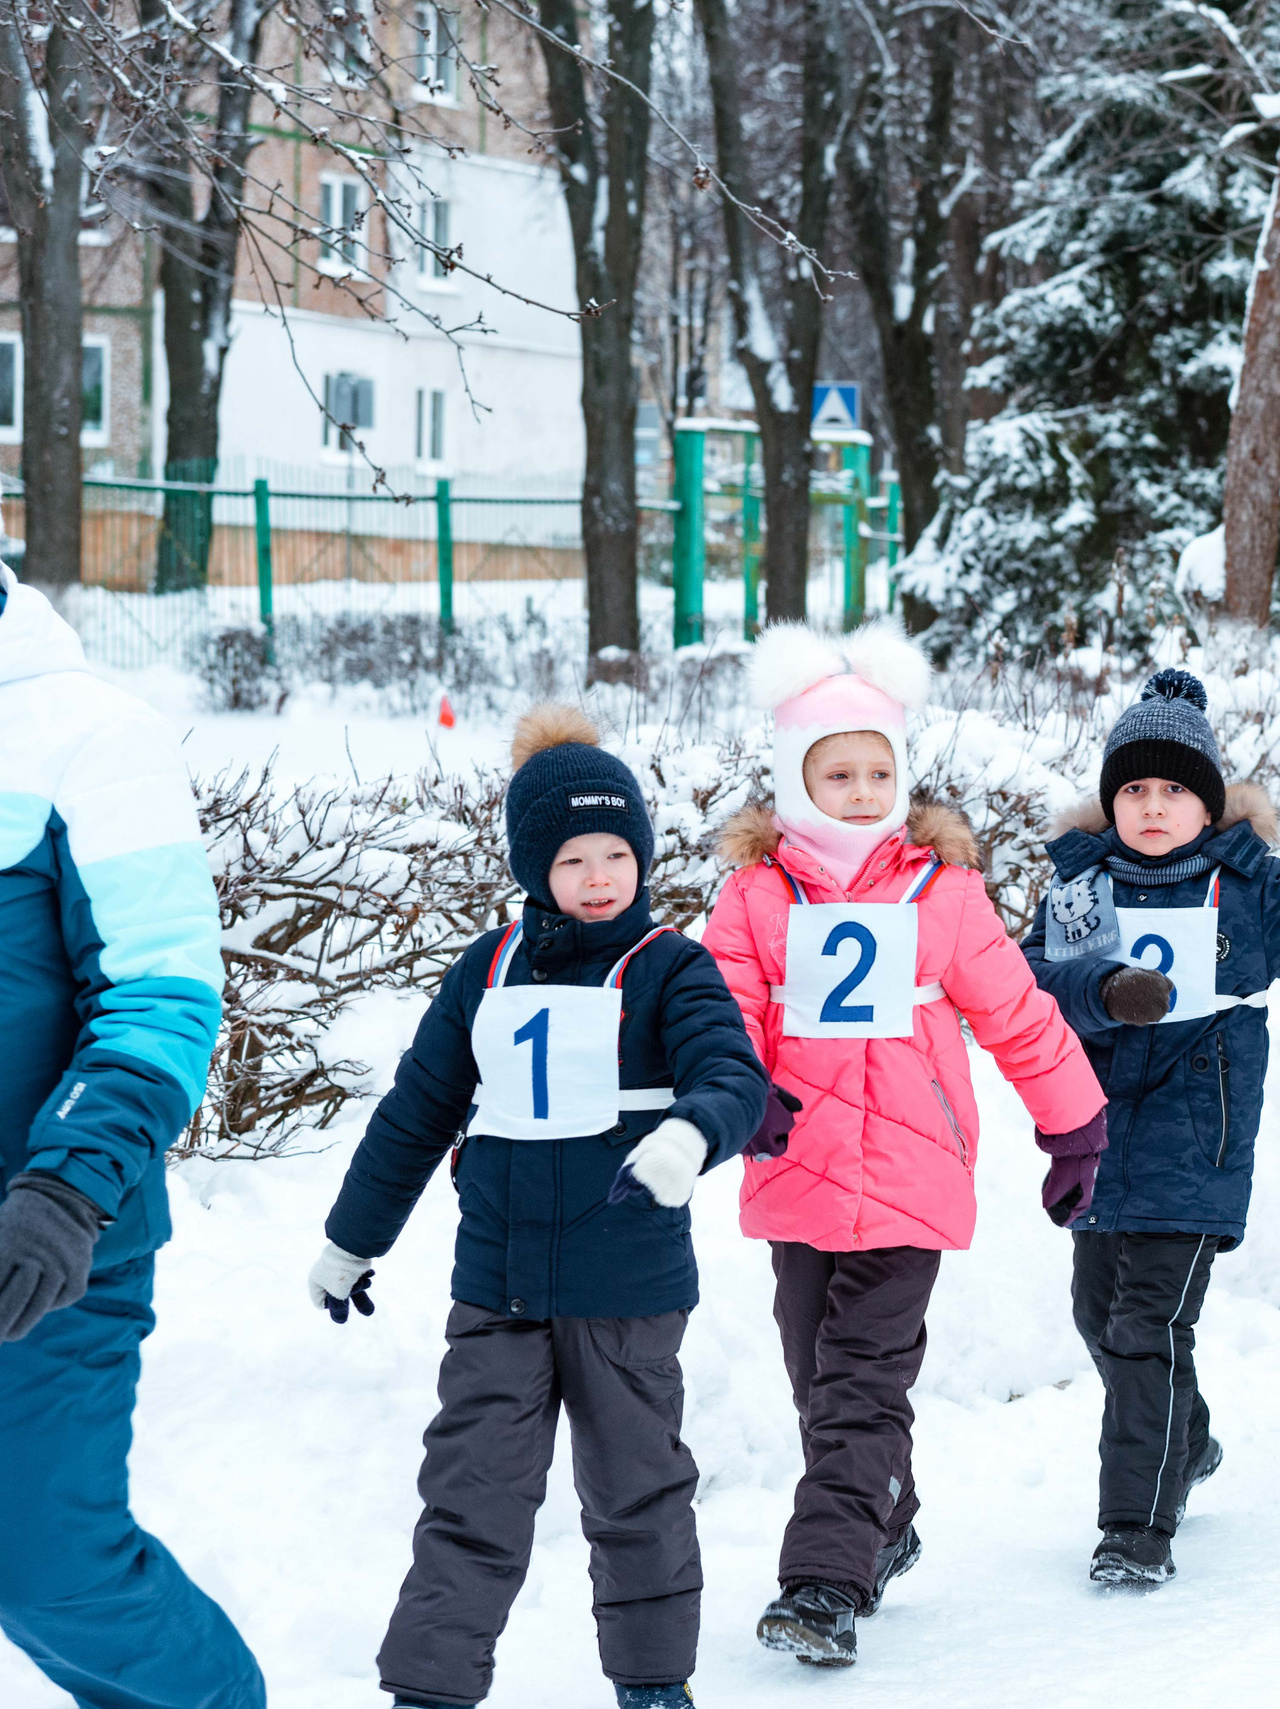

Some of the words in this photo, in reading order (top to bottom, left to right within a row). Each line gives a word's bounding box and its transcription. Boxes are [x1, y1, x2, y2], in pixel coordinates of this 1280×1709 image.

[571, 795, 610, 807] MOMMY'S
[611, 796, 626, 808] BOY
[819, 920, 878, 1023] 2
[1047, 942, 1085, 957] LITTLE
[1087, 930, 1117, 951] KING
[513, 1007, 550, 1120] 1
